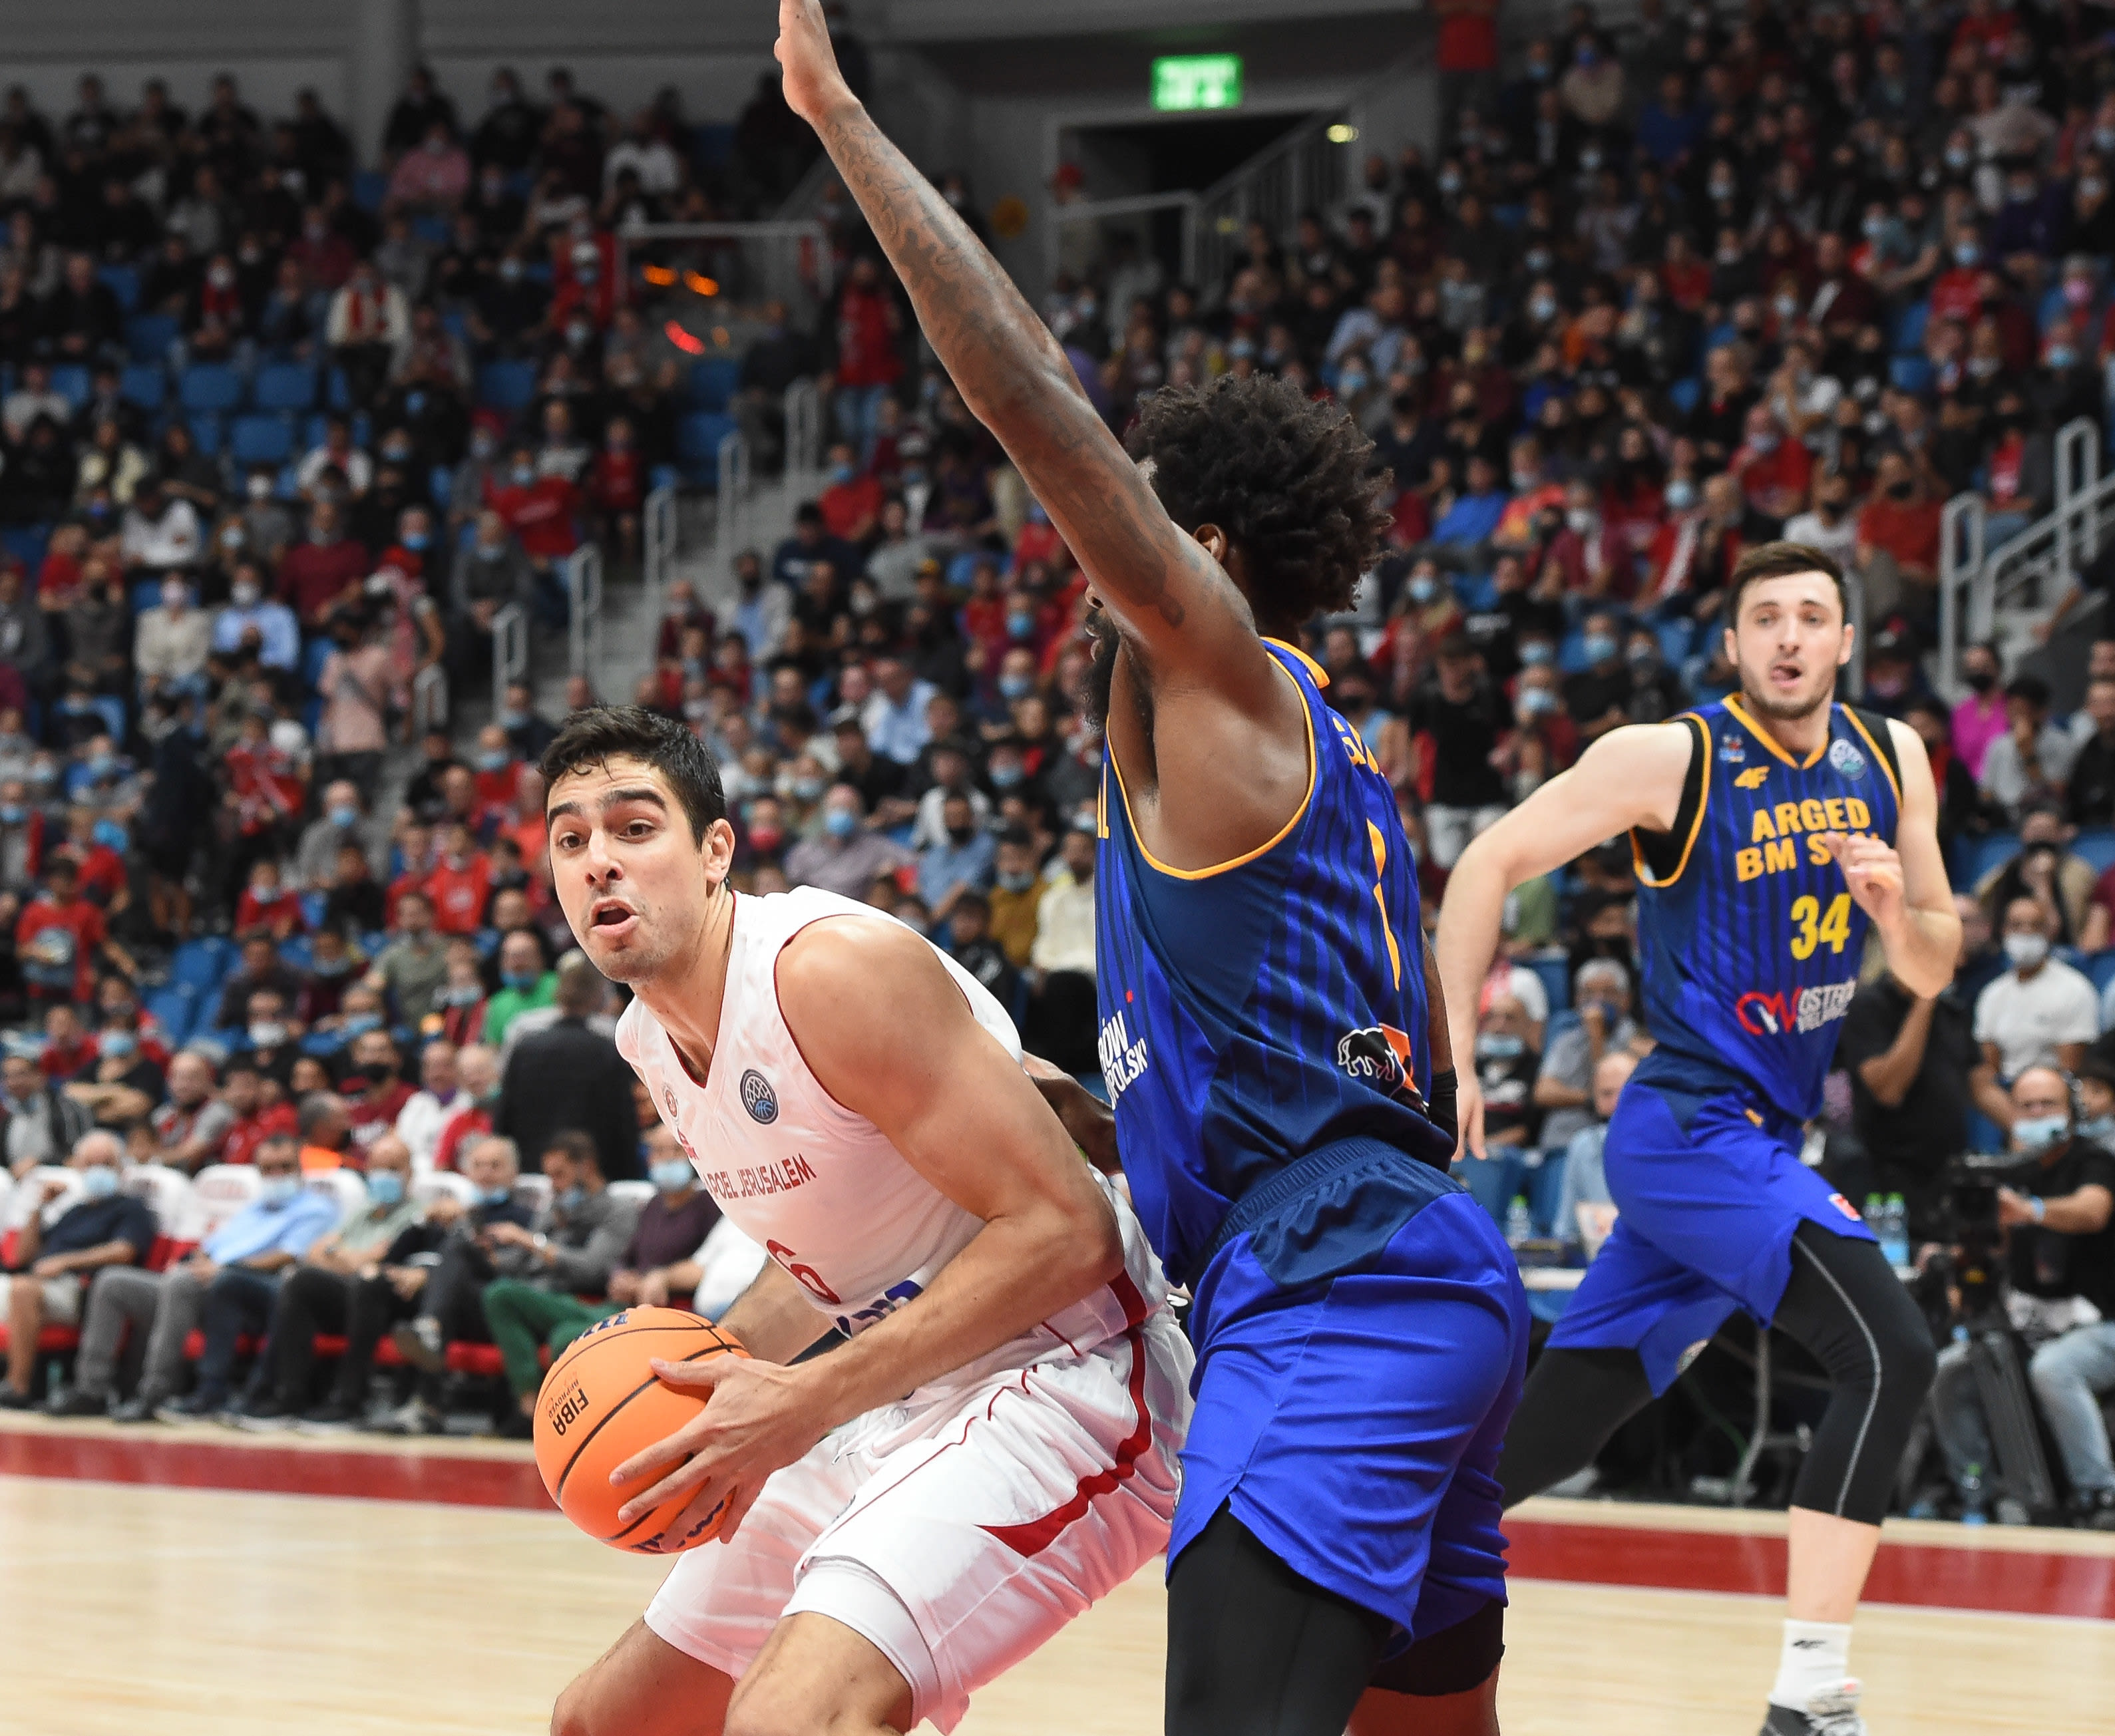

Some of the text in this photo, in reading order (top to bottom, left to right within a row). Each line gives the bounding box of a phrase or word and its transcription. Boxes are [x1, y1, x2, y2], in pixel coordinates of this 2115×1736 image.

[1734, 765, 1770, 790] 4F
[1751, 796, 1871, 844] ARGED
[1735, 836, 1798, 882] BM
[1790, 892, 1852, 961] 34
[736, 1152, 817, 1198] JERUSALEM
[766, 1238, 841, 1305] 6
[552, 1387, 590, 1436] FIBA
